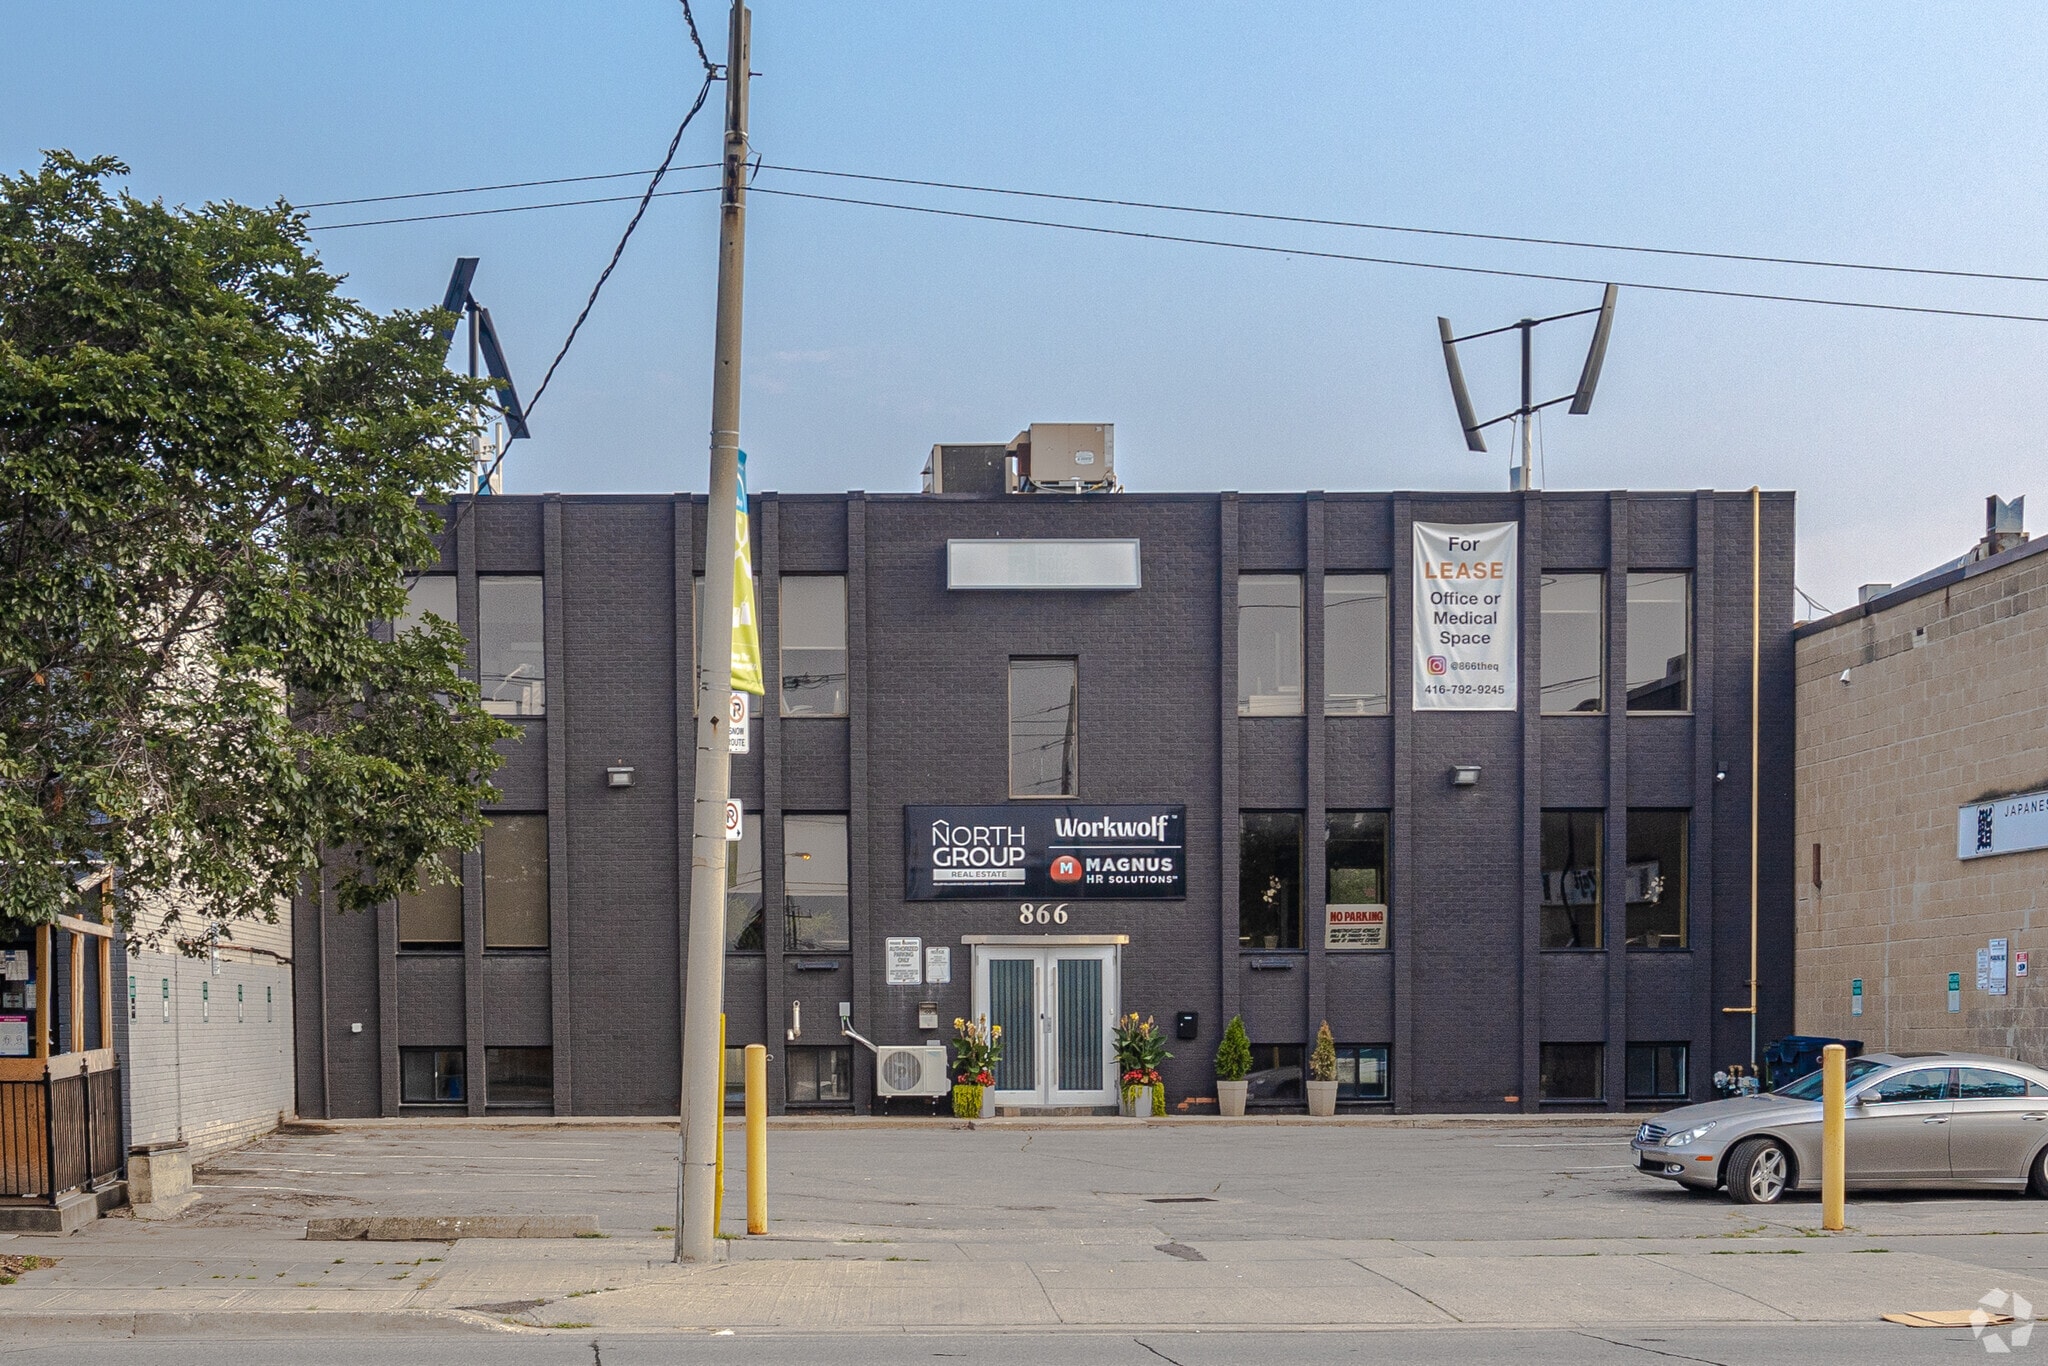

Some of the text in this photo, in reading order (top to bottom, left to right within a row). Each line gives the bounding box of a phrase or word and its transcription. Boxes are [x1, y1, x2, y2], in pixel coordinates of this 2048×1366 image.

[1448, 537, 1480, 552] For
[1424, 562, 1504, 580] LEASE
[1430, 591, 1501, 605] Office or
[1433, 611, 1497, 625] Medical
[1439, 631, 1491, 647] Space
[1450, 661, 1499, 672] @866theq
[1424, 684, 1505, 695] 416-792-9245
[932, 825, 1026, 846] NORTH
[1054, 815, 1169, 842] Workwolf
[932, 847, 1026, 867] GROUP
[1059, 857, 1173, 874] M MAGNUS
[951, 870, 1007, 878] REAL ESTATE
[1086, 875, 1104, 884] HR
[1019, 902, 1069, 925] 866
[1330, 911, 1384, 922] NO PARKING
